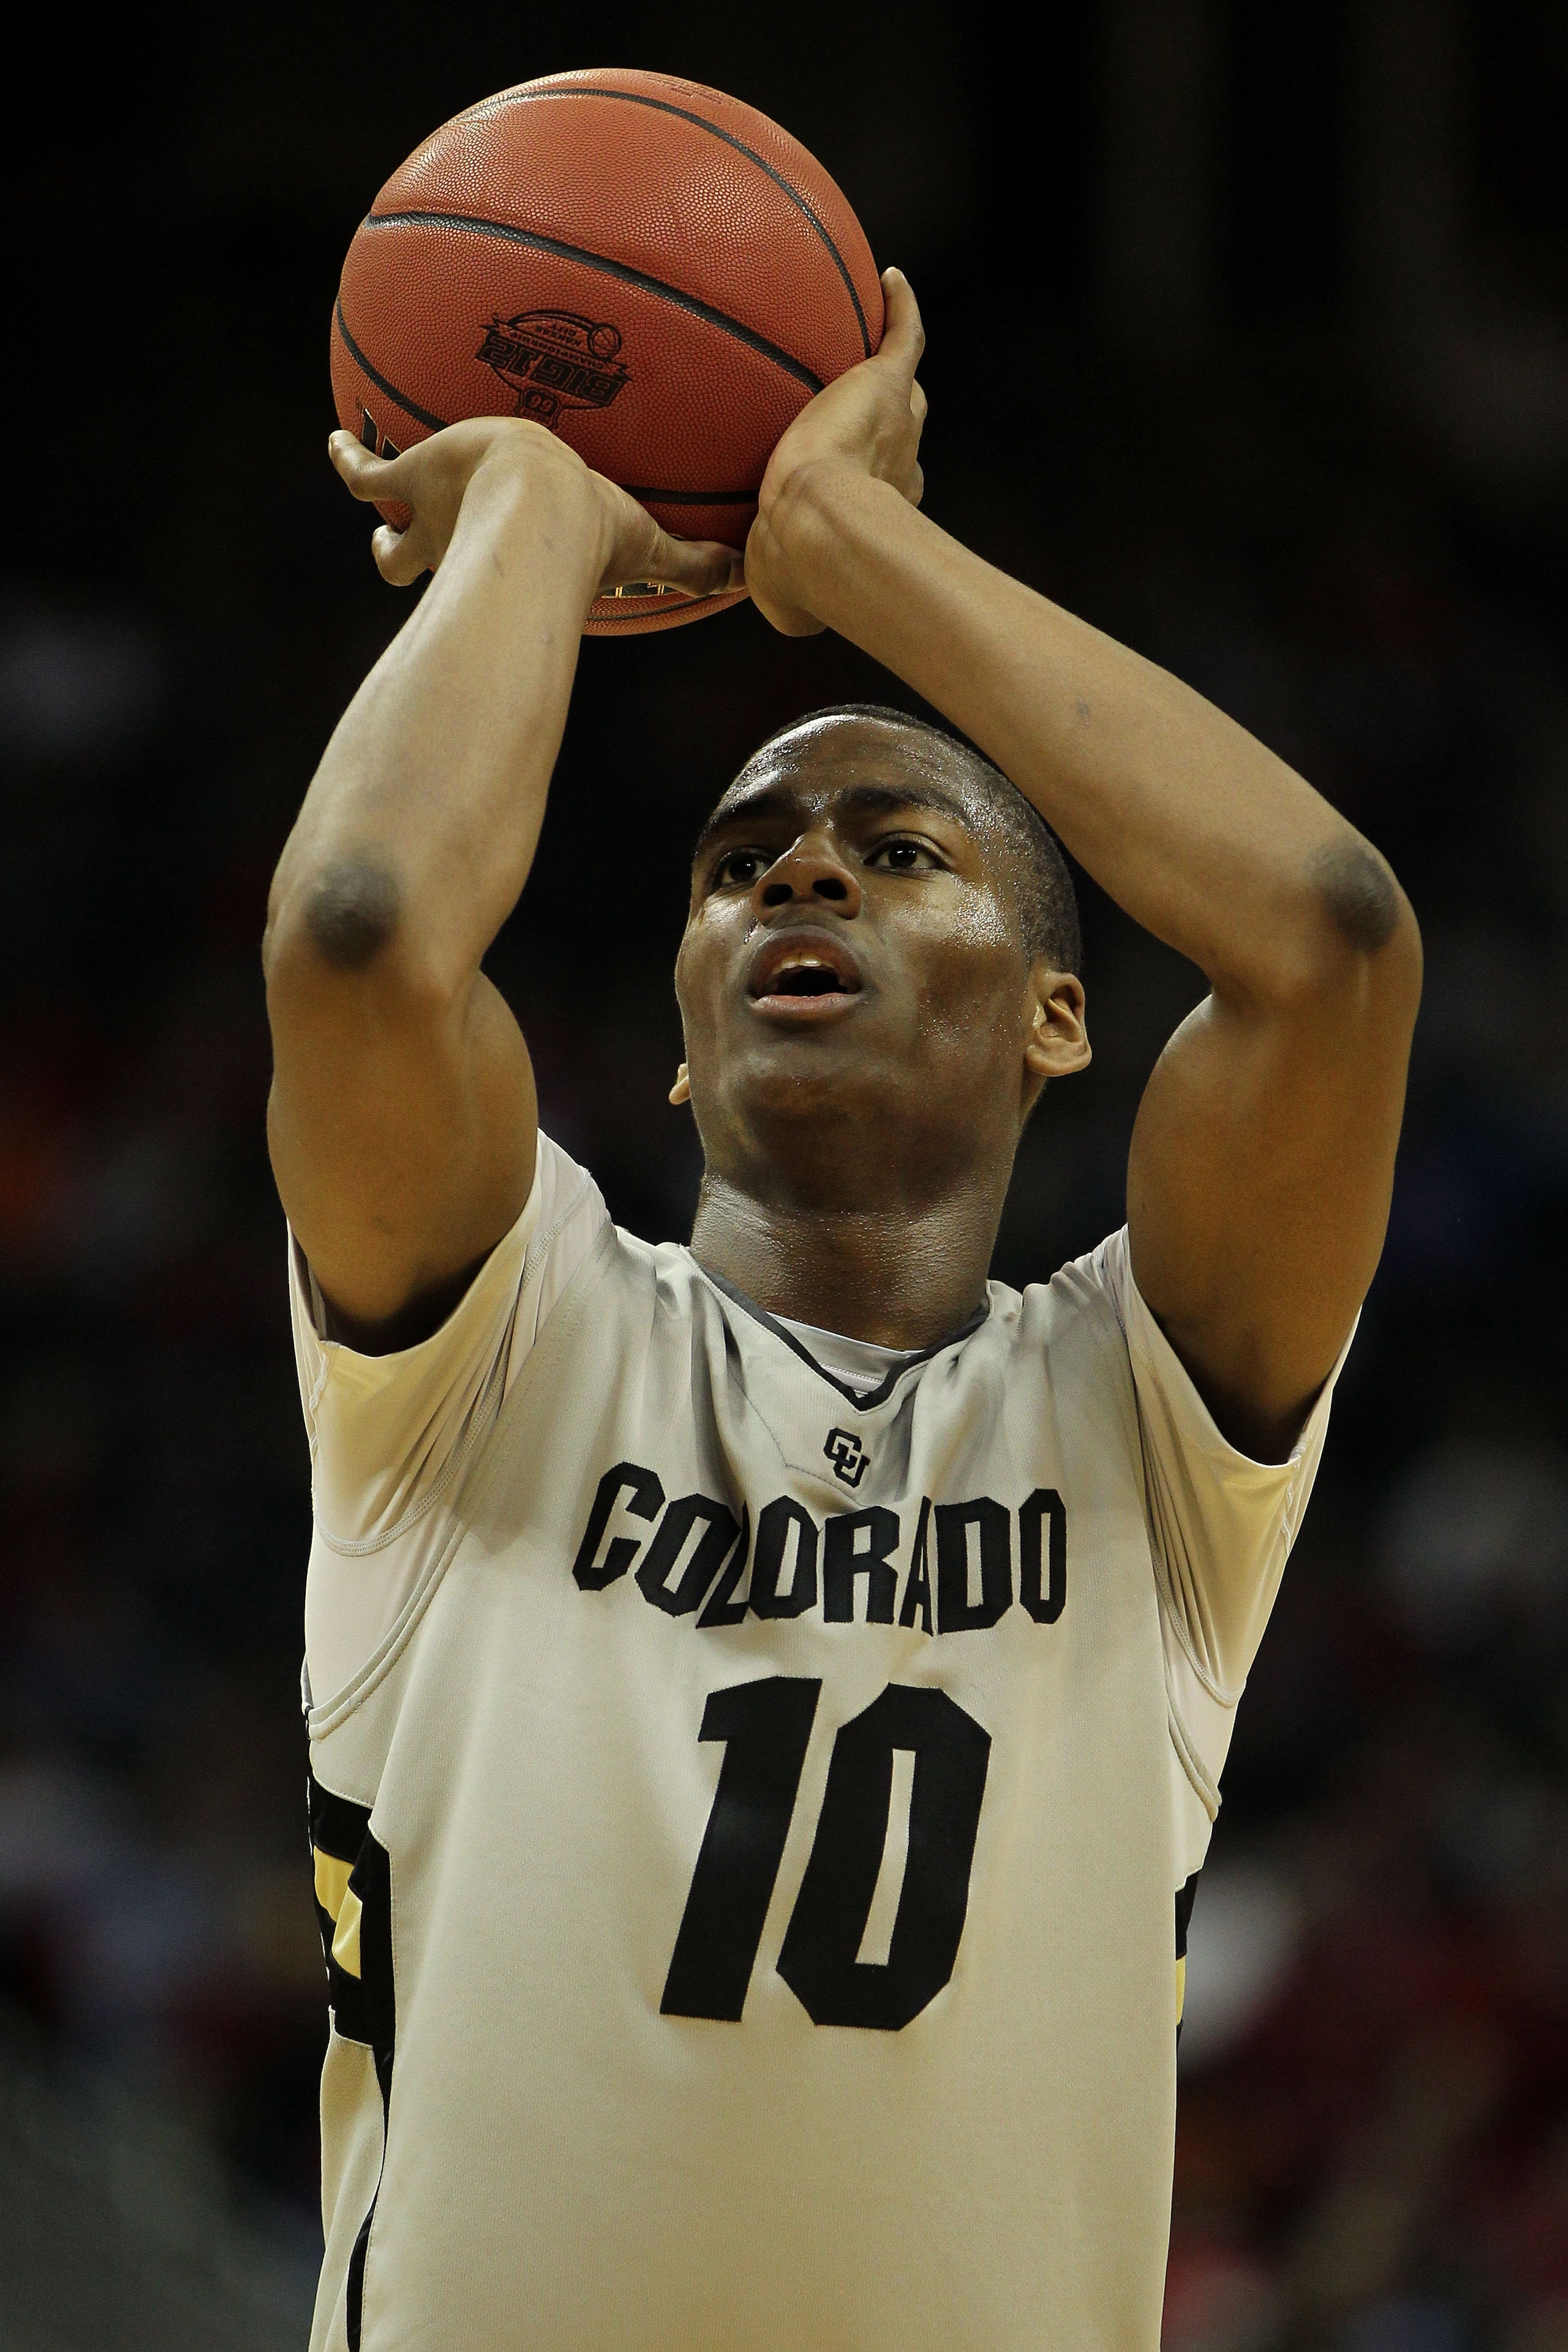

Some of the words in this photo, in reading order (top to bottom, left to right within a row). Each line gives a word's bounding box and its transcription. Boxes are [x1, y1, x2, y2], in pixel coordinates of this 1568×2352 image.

[510, 332, 604, 368] CHAMPIONSHIP
[536, 326, 581, 346] KANSAS
[552, 324, 577, 336] CITY
[476, 332, 540, 377] 12
[530, 354, 626, 405] BIG
[529, 394, 554, 412] 66
[572, 1461, 1067, 1637] COLORADO
[660, 1676, 992, 2031] 10
